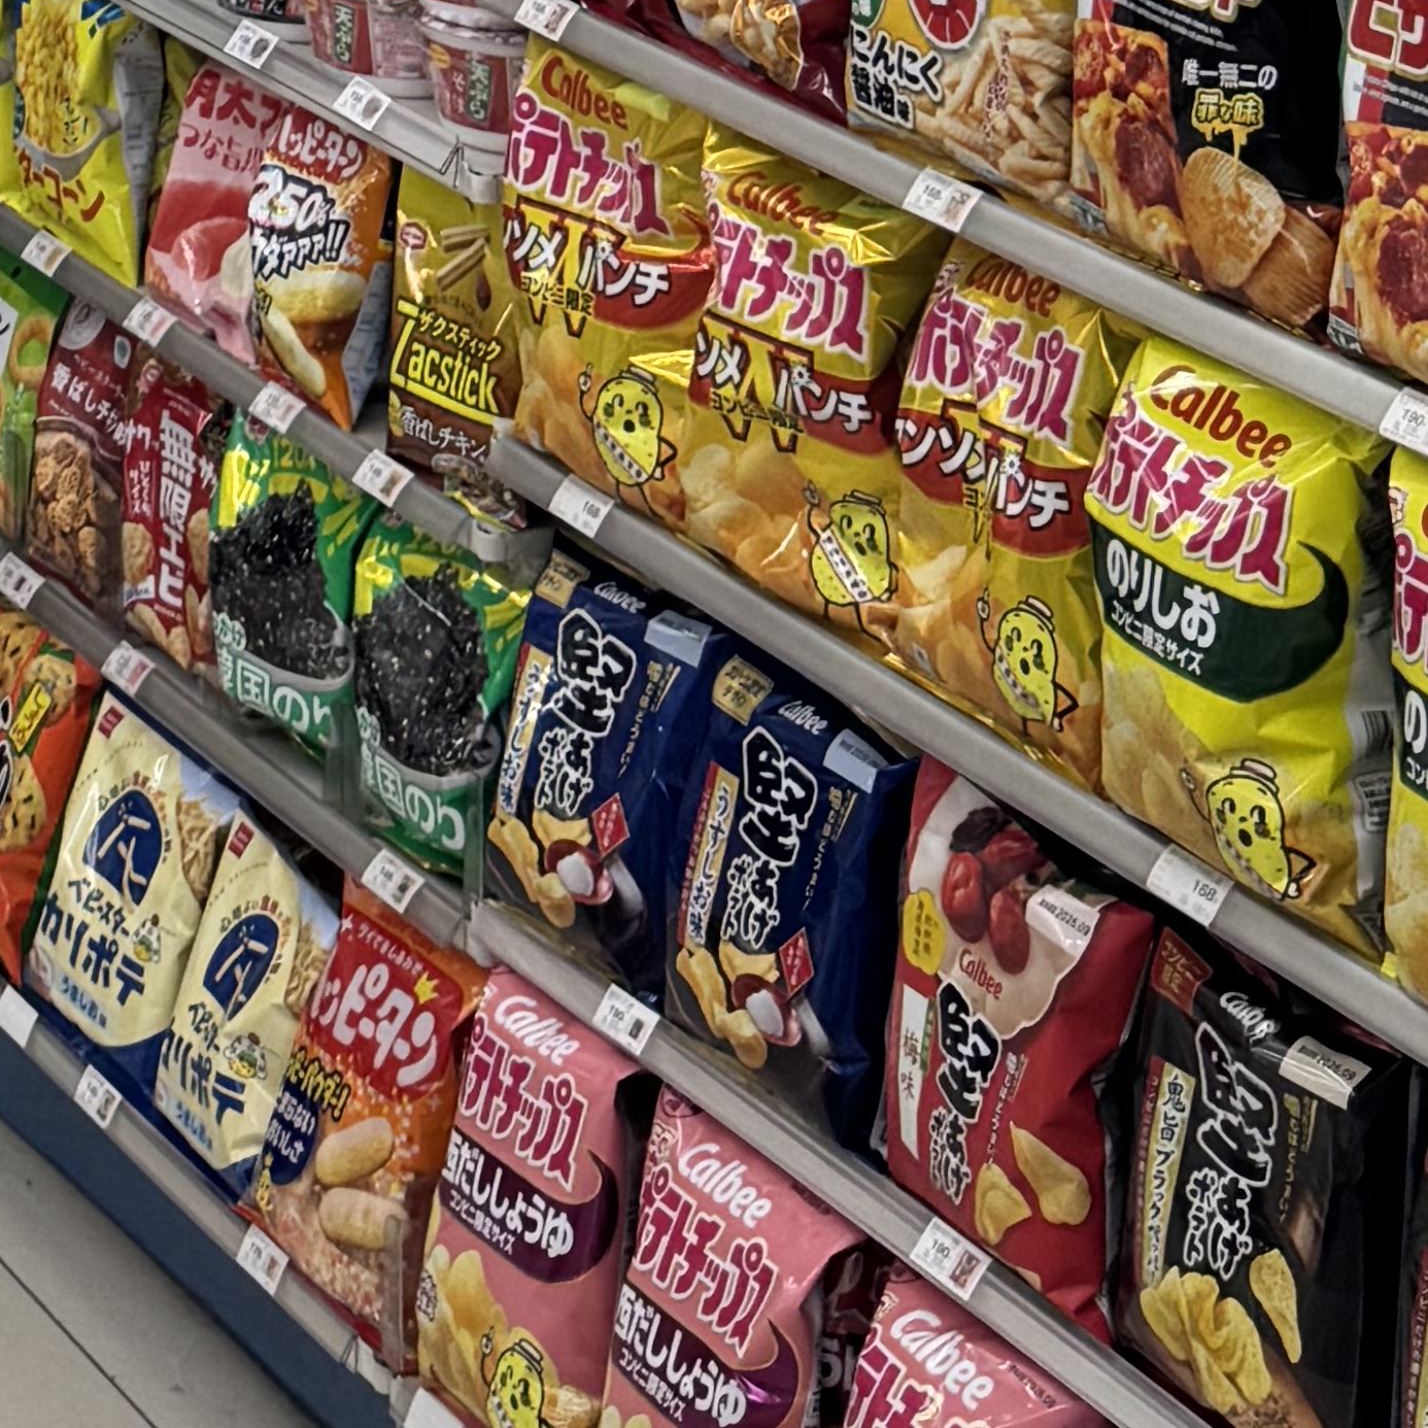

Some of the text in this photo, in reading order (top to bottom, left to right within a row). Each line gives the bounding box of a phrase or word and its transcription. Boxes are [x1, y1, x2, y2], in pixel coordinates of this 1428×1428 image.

[541, 54, 629, 131] Calbee
[577, 237, 670, 307] パンチ
[964, 255, 1063, 317] Calbee
[776, 361, 874, 433] パンチ
[1147, 361, 1293, 471] Calbee
[993, 453, 1071, 528] パンチ
[1105, 538, 1219, 651] のりしお
[957, 948, 1004, 1000] Calbee
[493, 995, 582, 1066] Calbee
[677, 1144, 773, 1229] Calbee
[888, 1306, 996, 1408] Calbee
